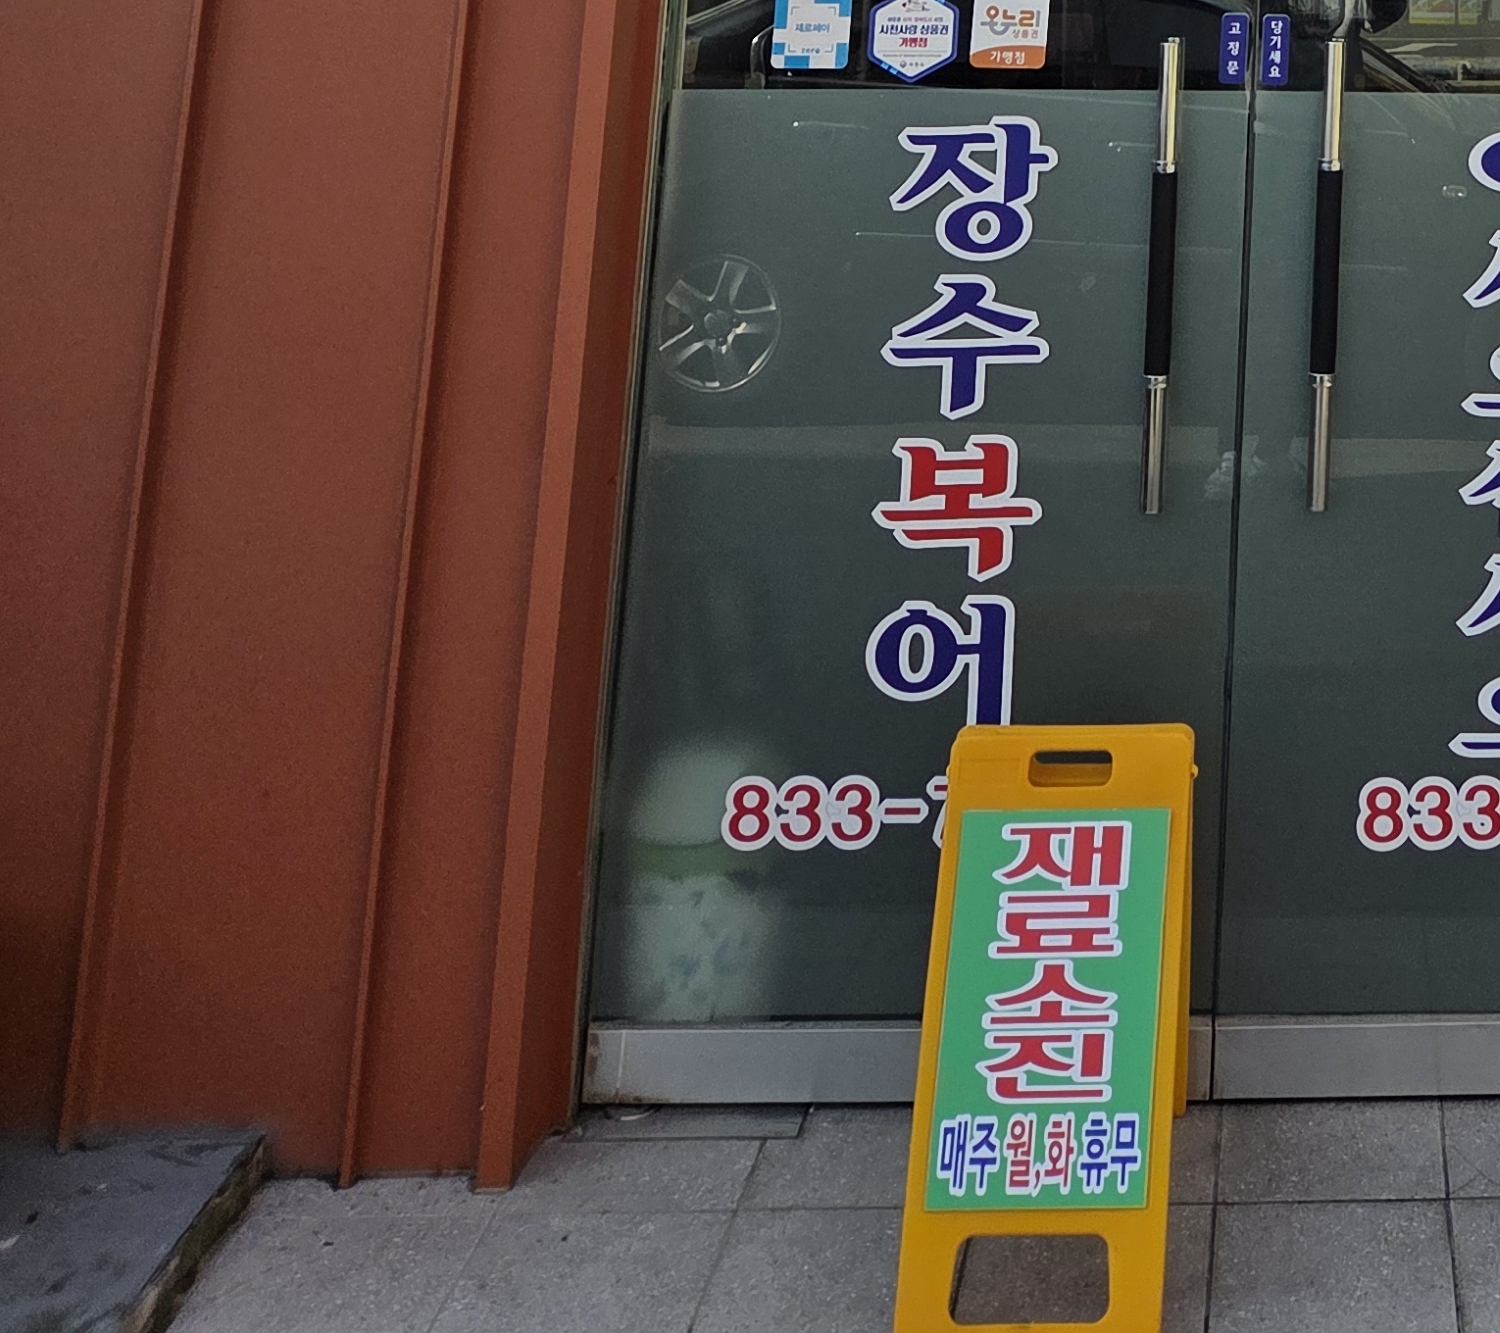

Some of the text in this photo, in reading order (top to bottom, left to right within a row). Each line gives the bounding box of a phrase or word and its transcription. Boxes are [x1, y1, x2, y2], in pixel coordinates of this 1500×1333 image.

[990, 51, 1025, 65] 가맹점
[1226, 21, 1242, 76] 고정문
[1268, 19, 1284, 78] 당기세요
[867, 117, 1057, 725] 장수복어
[937, 1112, 1141, 1197] 매주 월,화 휴무
